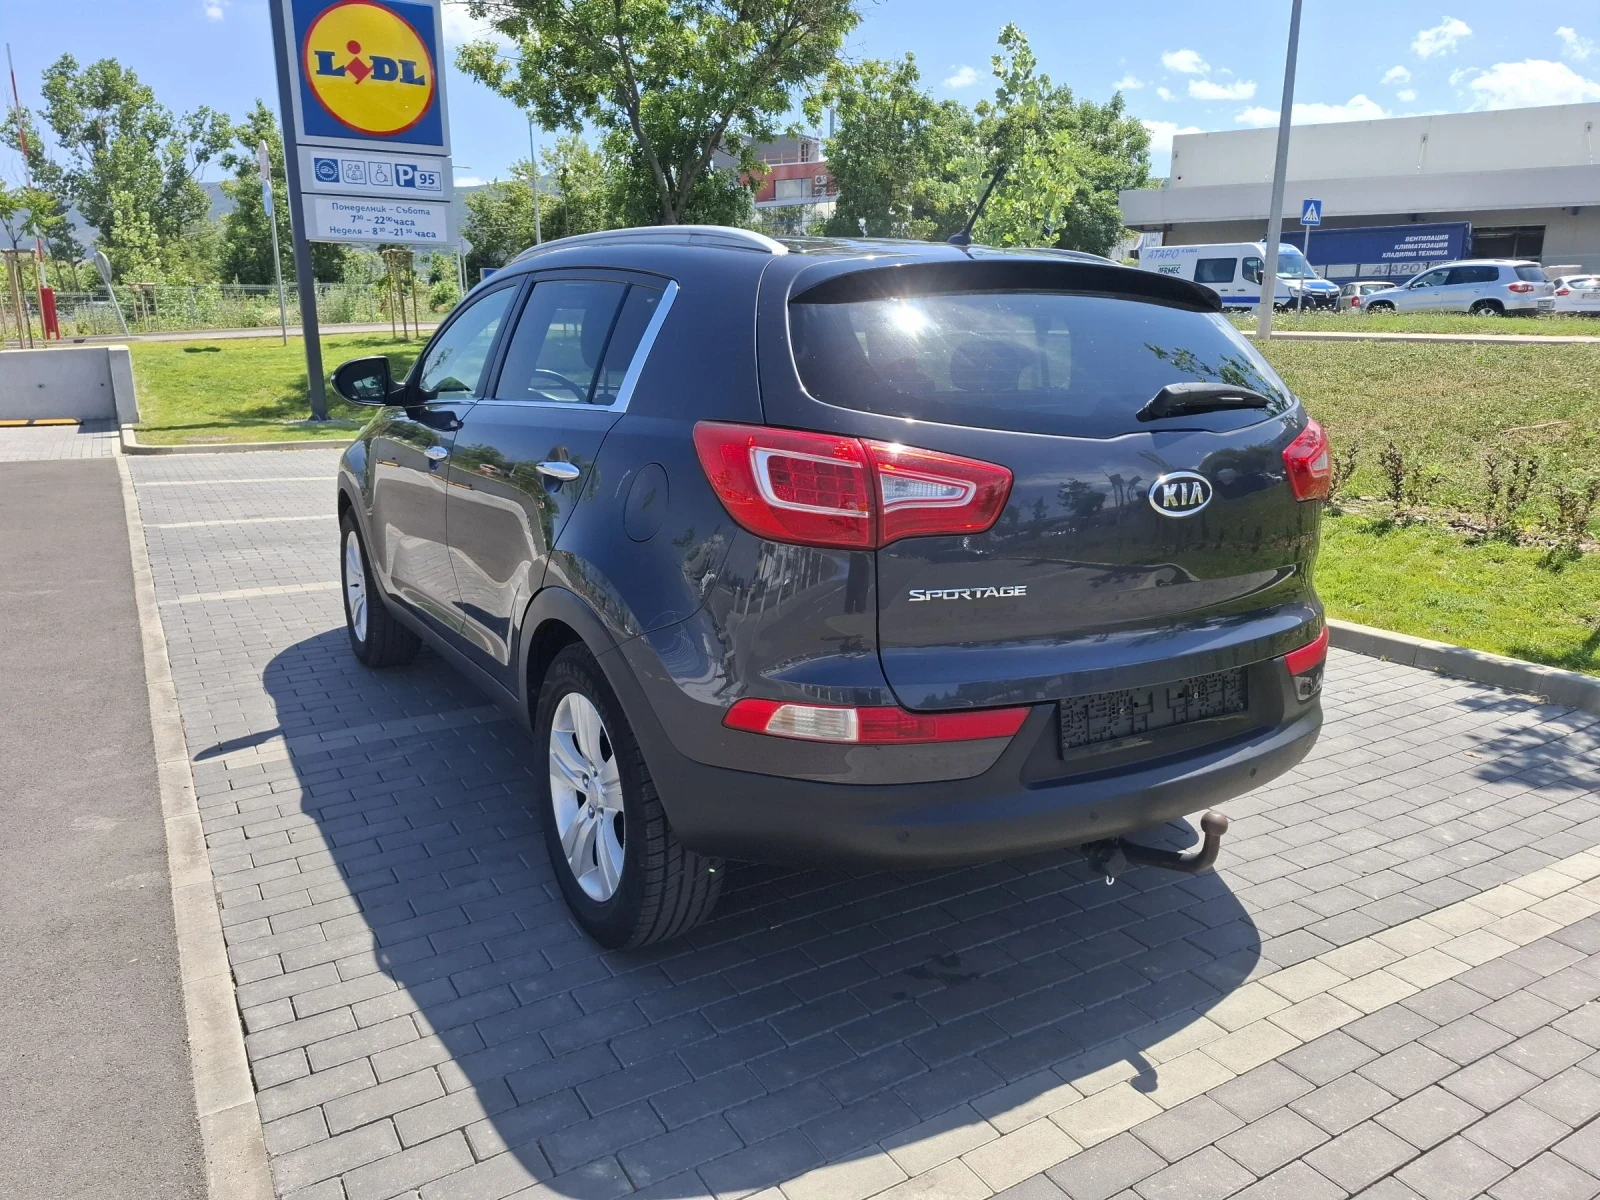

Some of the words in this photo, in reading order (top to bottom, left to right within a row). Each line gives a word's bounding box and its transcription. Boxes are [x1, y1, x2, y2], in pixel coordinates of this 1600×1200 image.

[419, 173, 435, 185] 95
[331, 202, 387, 213] Понеделник
[395, 206, 431, 216] Събота
[329, 226, 363, 236] Неделя
[1404, 234, 1449, 242] ВЕНТИЛАЦИЯ
[1394, 242, 1449, 250] КЛИМАТИЗАЦИЯ
[1418, 249, 1448, 257] ТЕХНИКА
[1161, 483, 1204, 507] KIA
[908, 585, 1027, 602] SPORTAGE
